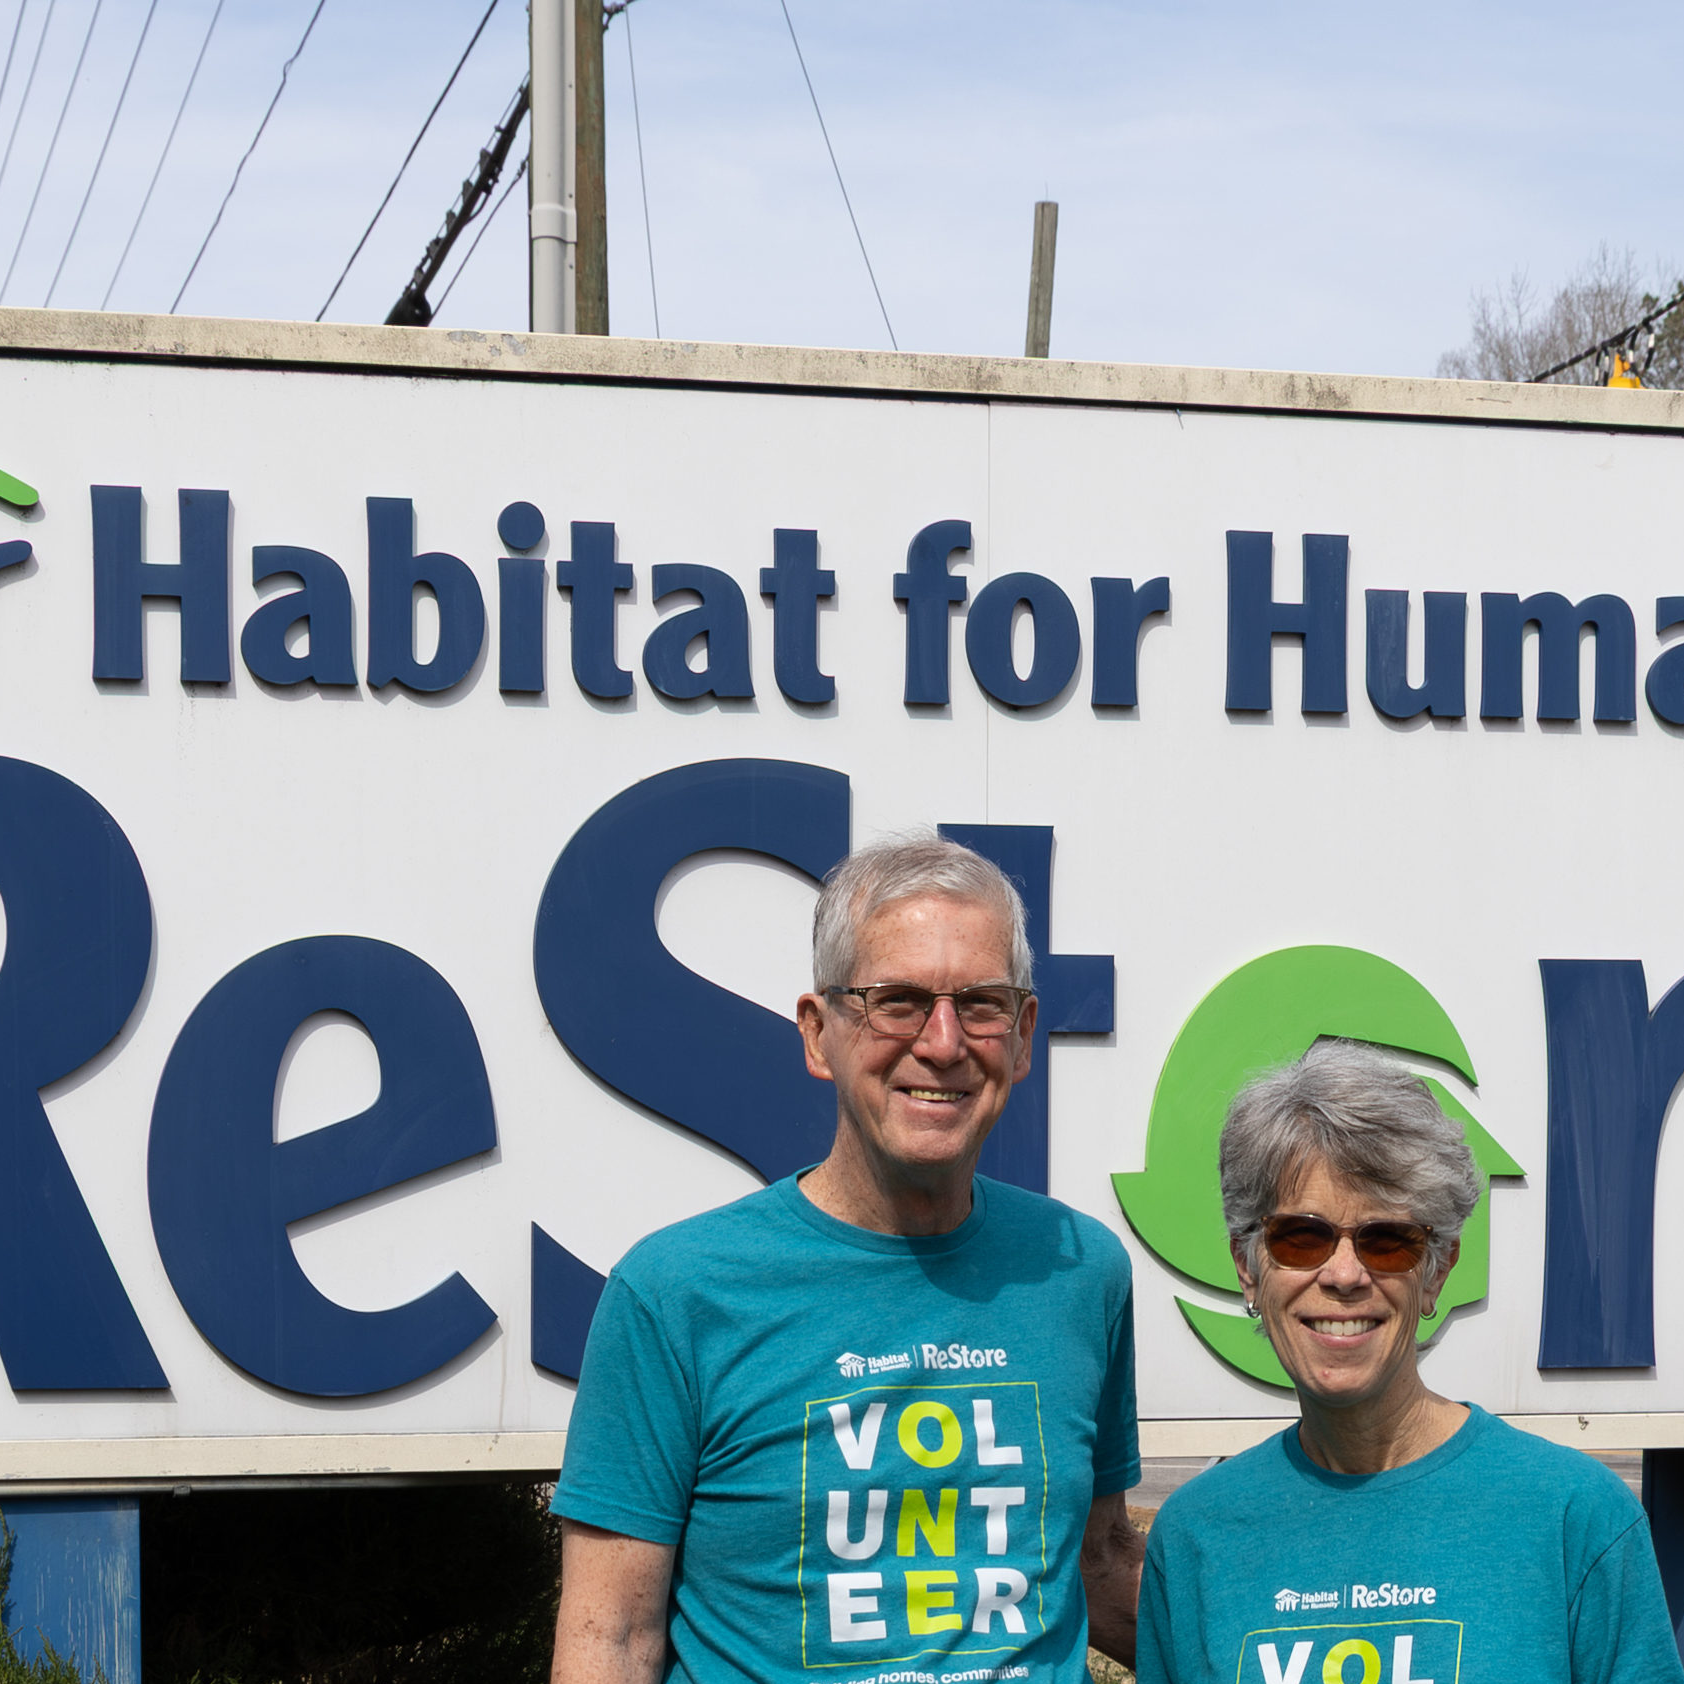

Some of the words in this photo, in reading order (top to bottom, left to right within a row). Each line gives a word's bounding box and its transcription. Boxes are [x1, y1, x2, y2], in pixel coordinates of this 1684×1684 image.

[90, 484, 837, 704] Habitat
[891, 519, 1170, 710] for
[867, 1352, 909, 1369] Habitat
[921, 1343, 1008, 1370] ReStore
[827, 1399, 1023, 1470] VOL
[826, 1487, 1026, 1560] UNT
[827, 1568, 1028, 1643] EER
[1301, 1591, 1339, 1604] Habitat
[1351, 1583, 1437, 1609] ReStore
[940, 1665, 1029, 1684] commnities
